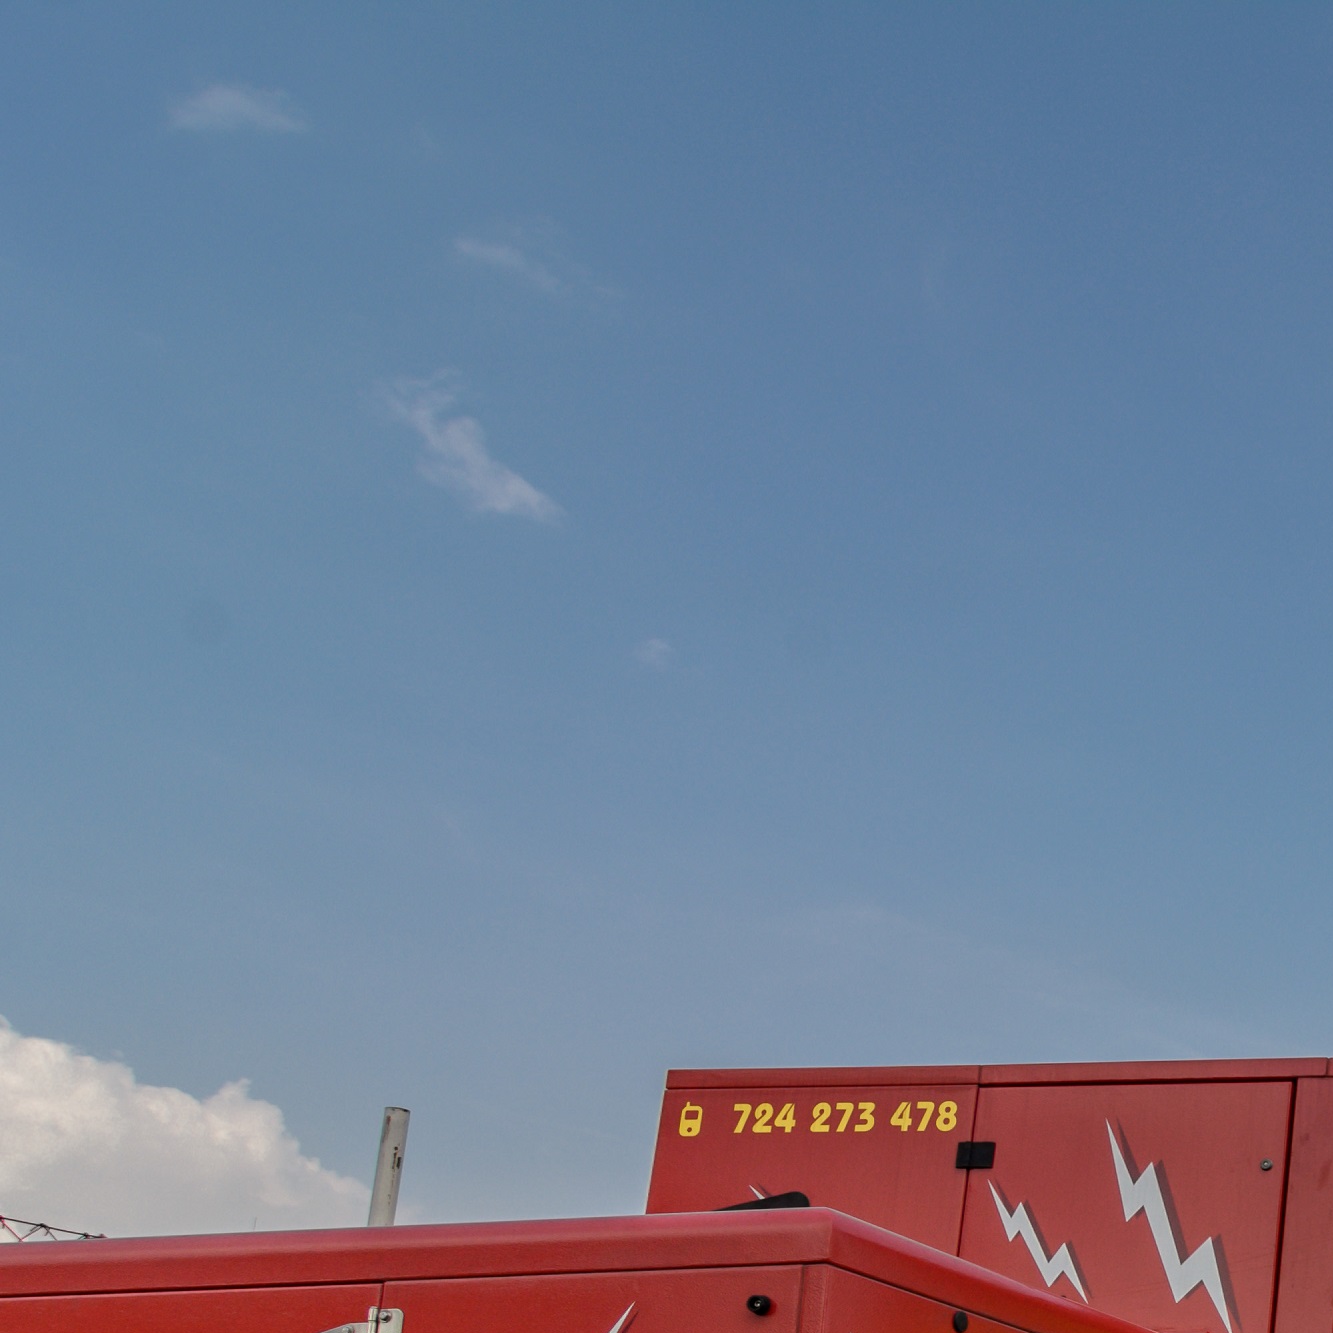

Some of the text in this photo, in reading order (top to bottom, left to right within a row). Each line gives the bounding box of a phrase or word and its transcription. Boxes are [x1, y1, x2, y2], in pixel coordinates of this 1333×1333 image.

[733, 1100, 958, 1134] 724 273 478
